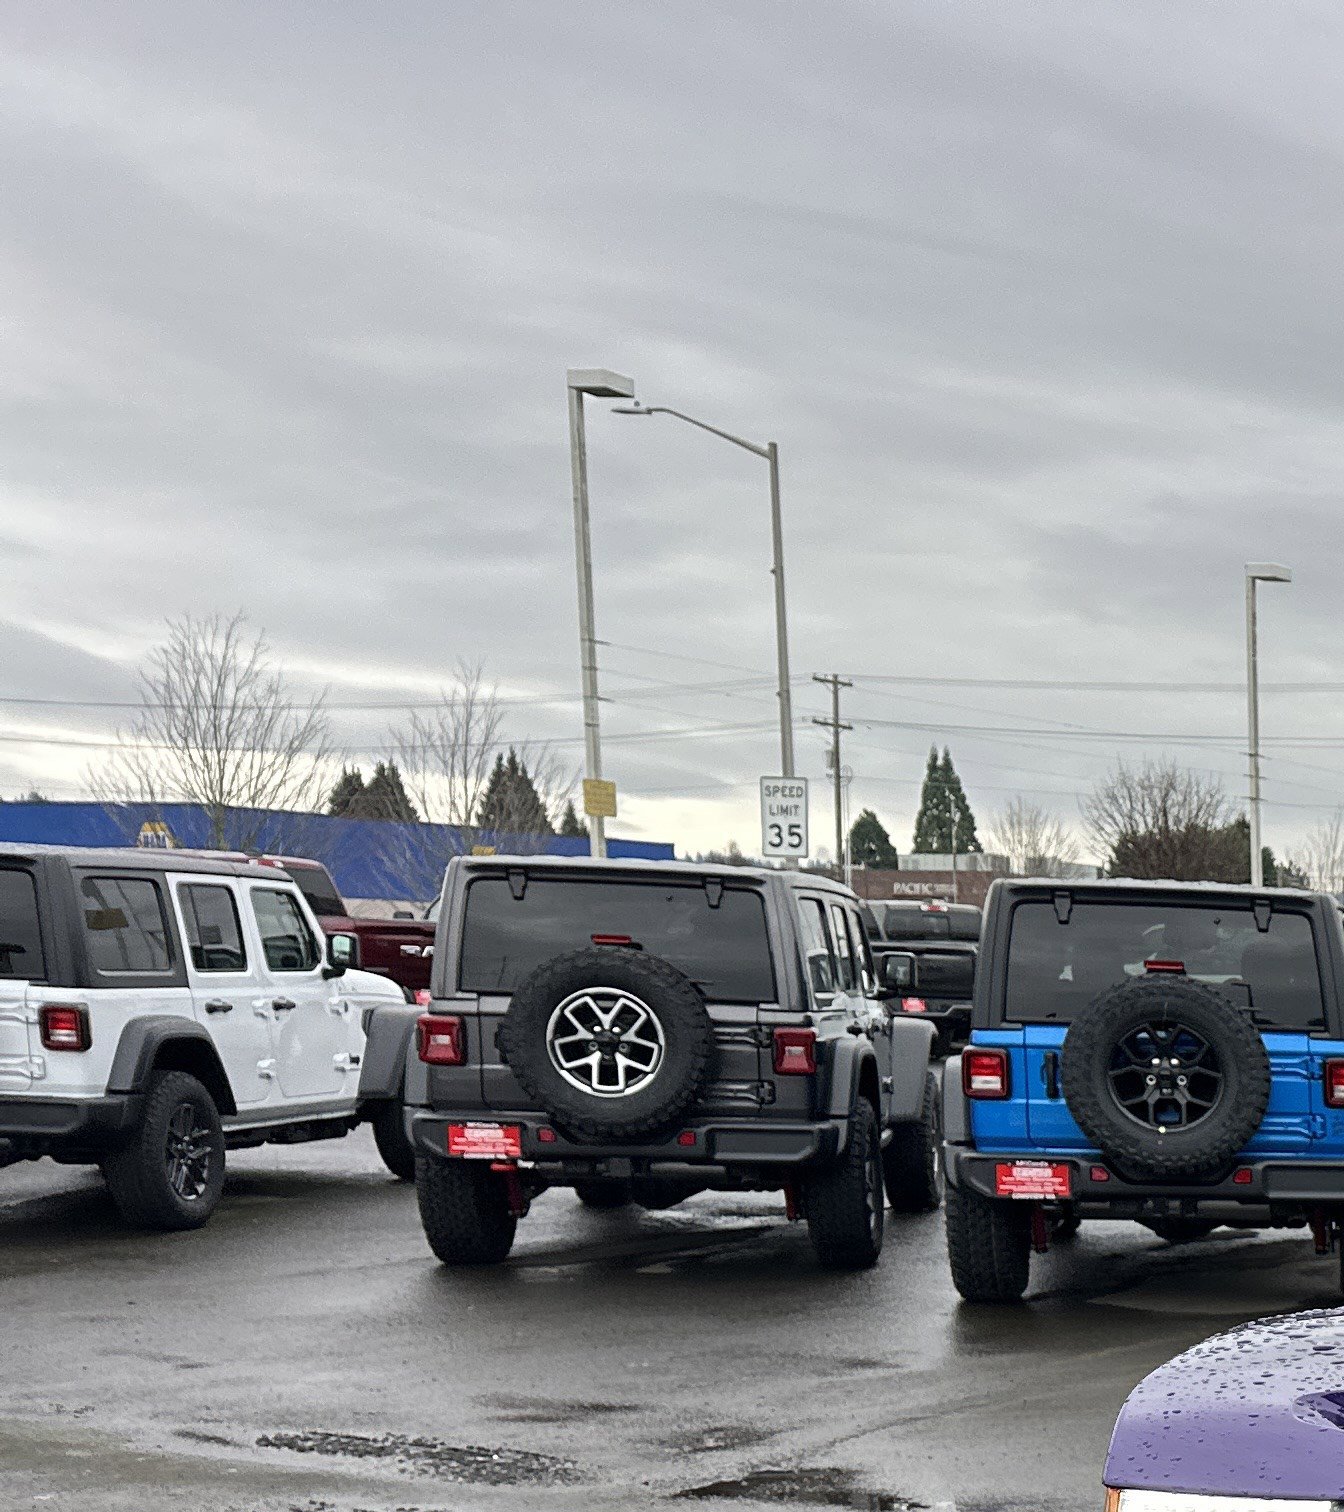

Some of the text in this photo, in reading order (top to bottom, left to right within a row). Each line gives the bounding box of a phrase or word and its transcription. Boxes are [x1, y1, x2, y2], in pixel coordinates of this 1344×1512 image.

[764, 785, 804, 798] SPEED
[768, 804, 801, 816] LIMIT
[768, 823, 802, 848] 35
[893, 882, 933, 895] PACIFIC
